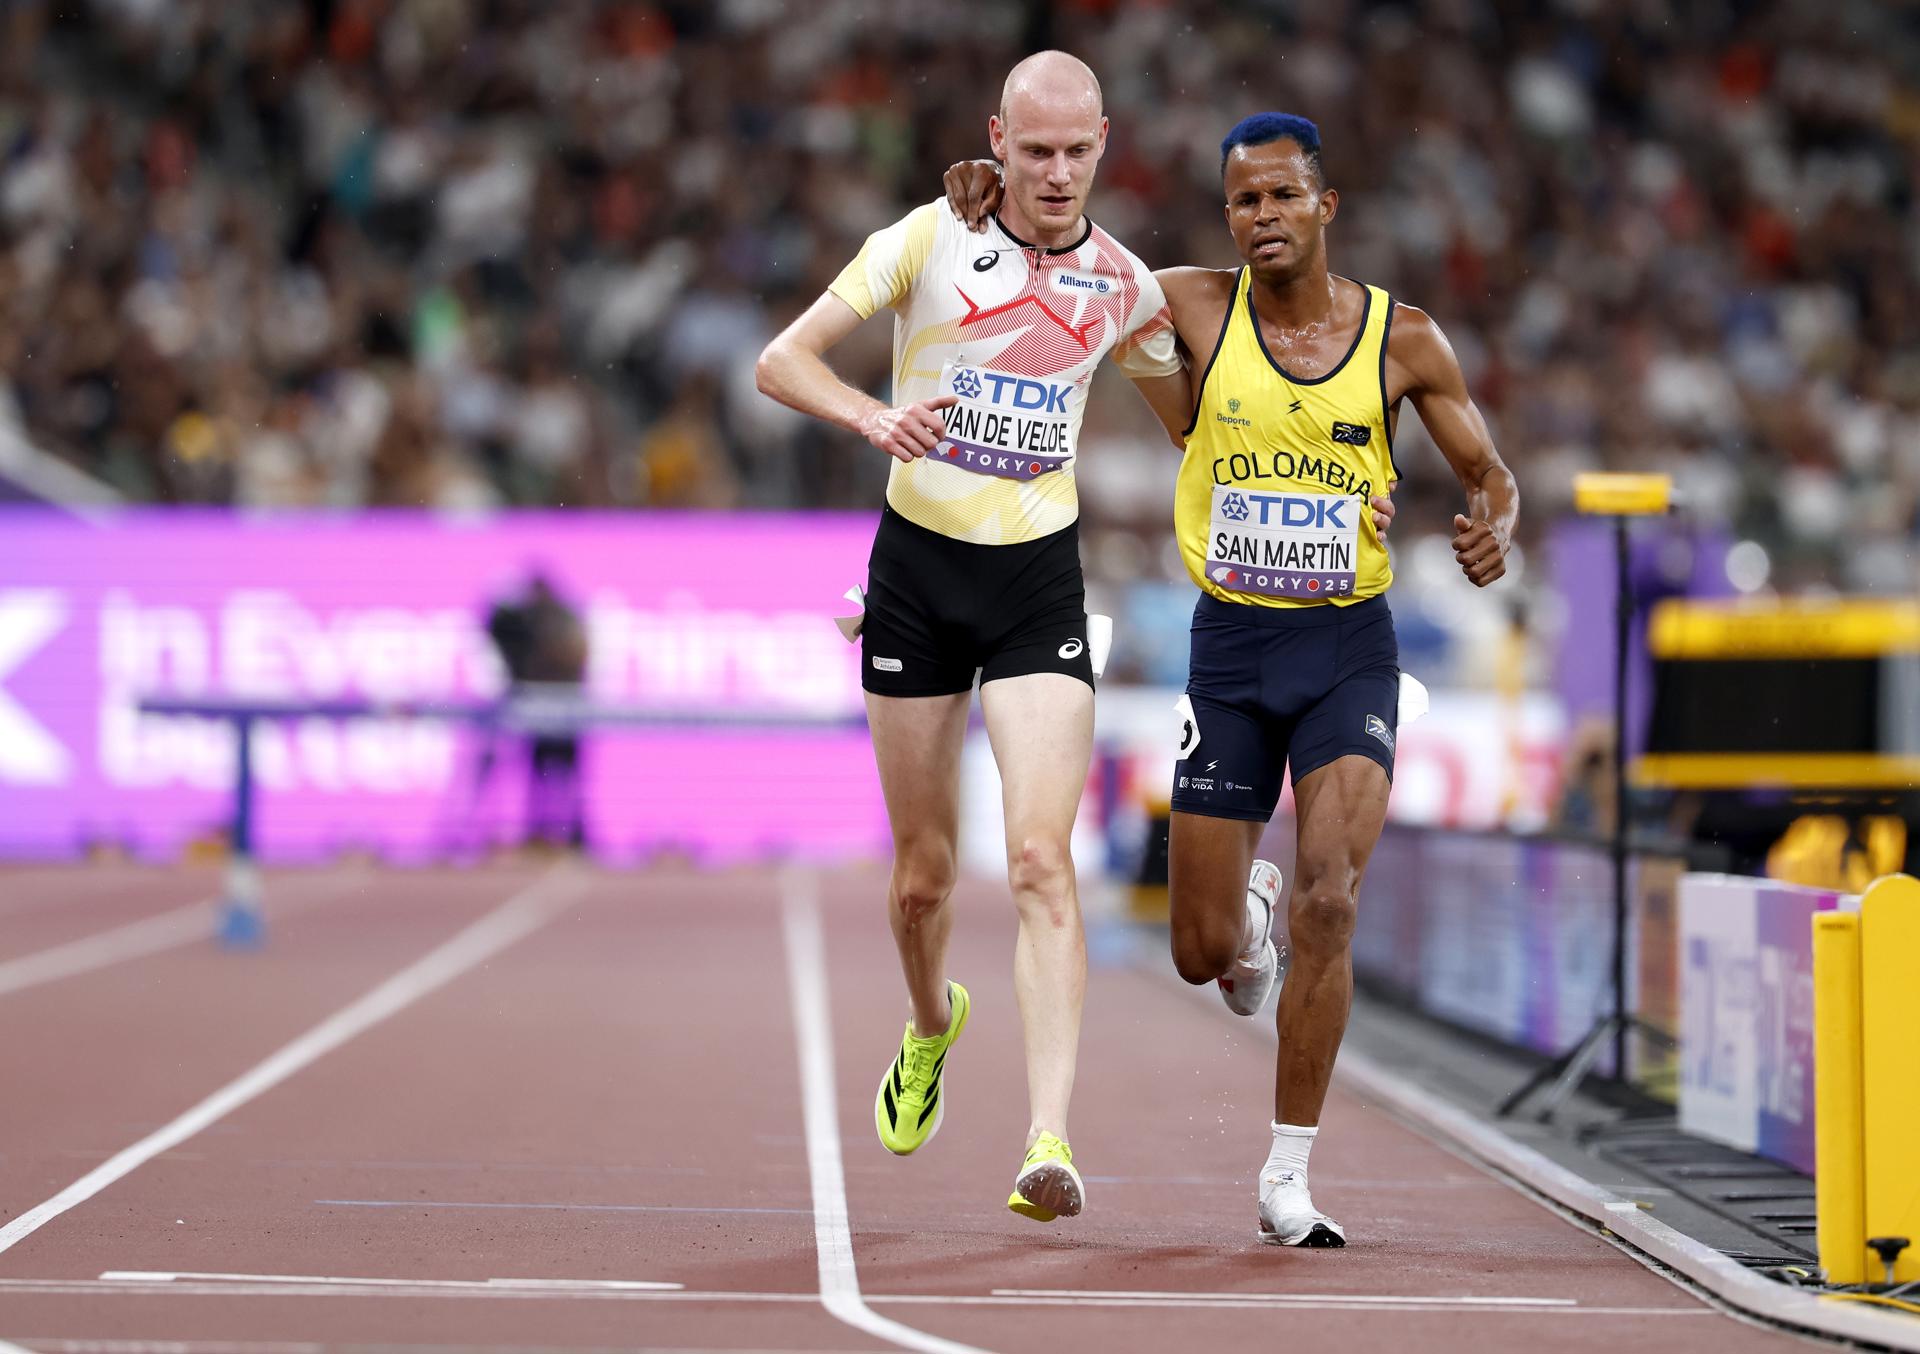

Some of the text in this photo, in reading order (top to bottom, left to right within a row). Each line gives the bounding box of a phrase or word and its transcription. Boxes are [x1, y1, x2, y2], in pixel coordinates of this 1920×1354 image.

[1059, 274, 1094, 289] Allianz
[984, 372, 1075, 413] TDK
[942, 404, 982, 440] VAN
[983, 413, 1013, 447] DE
[1217, 413, 1251, 427] Deporte
[1213, 451, 1372, 507] COLOMBIA
[1249, 494, 1347, 528] TDK
[1214, 532, 1350, 570] SAN MARTÍN
